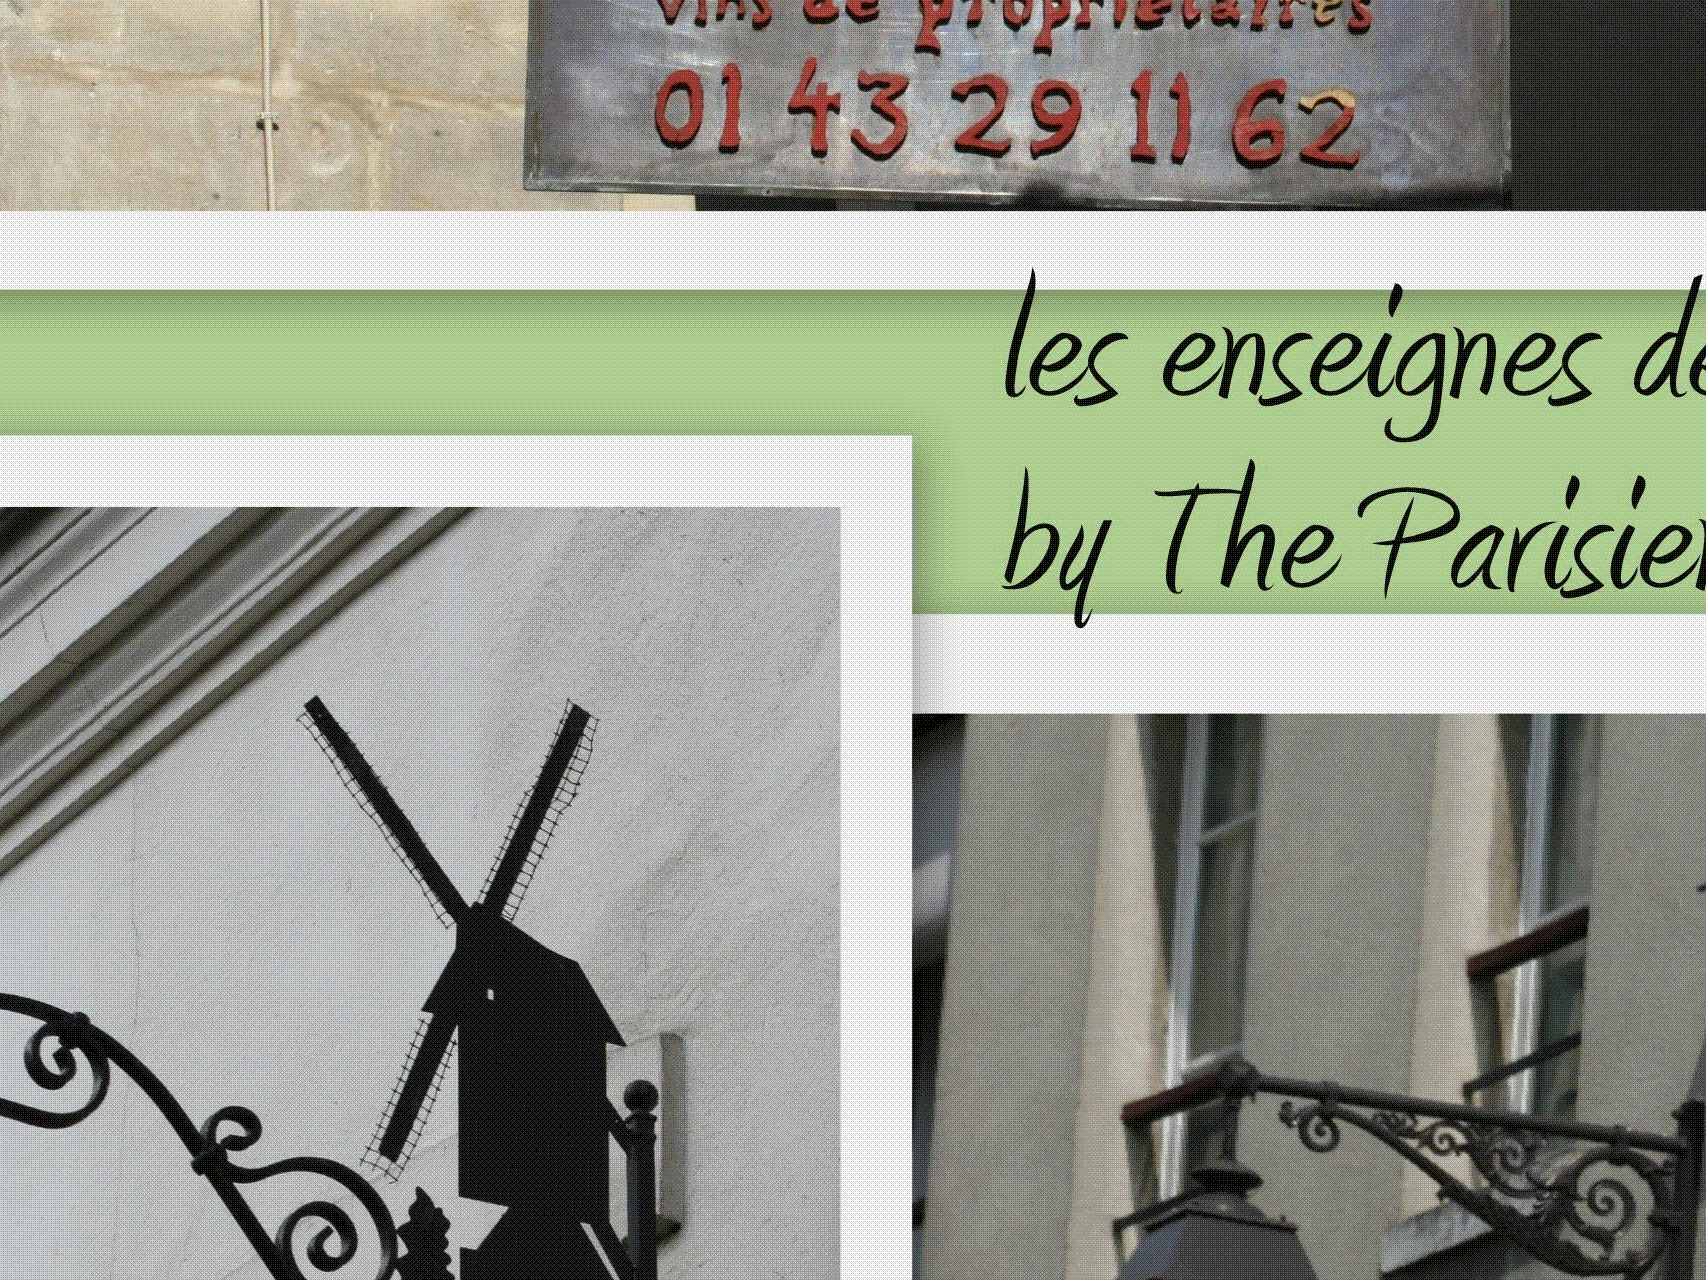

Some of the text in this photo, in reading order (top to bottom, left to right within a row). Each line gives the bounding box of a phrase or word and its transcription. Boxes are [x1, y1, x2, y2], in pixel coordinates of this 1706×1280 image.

[653, 56, 1363, 170] 01 43 29 11 62
